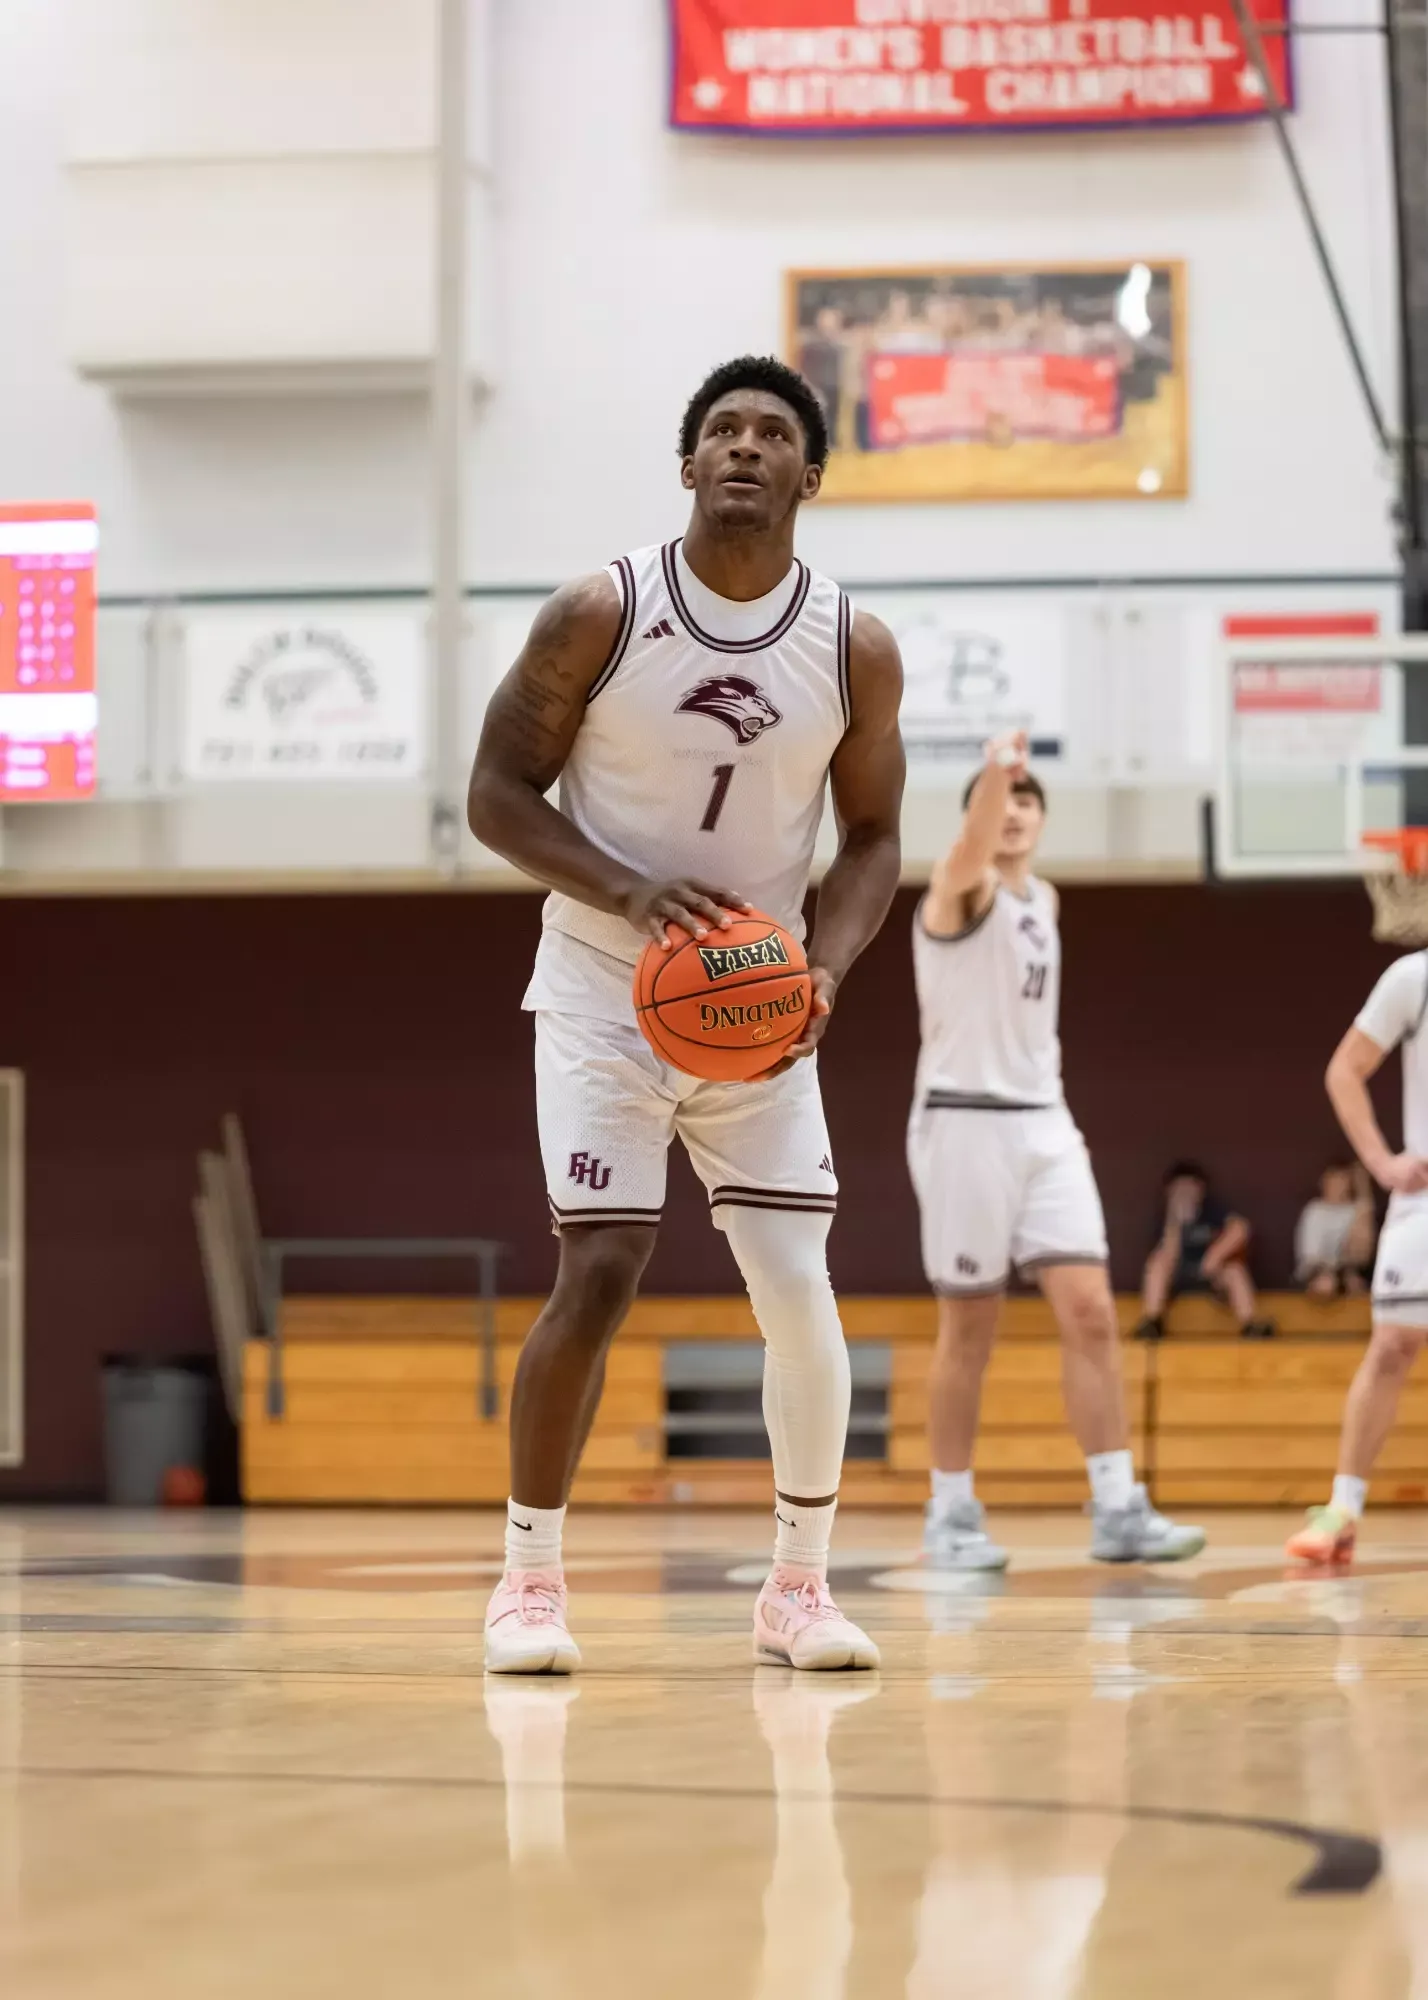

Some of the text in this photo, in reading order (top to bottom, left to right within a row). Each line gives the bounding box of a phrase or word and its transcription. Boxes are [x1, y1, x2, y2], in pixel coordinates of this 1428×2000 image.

[723, 14, 1237, 74] WOMEN'S BASKETBALL
[747, 62, 1212, 117] NATIONAL CHAMPION
[699, 763, 736, 833] 1
[698, 932, 790, 982] NAIA
[700, 984, 805, 1032] SPALDING
[568, 1151, 612, 1190] FHU
